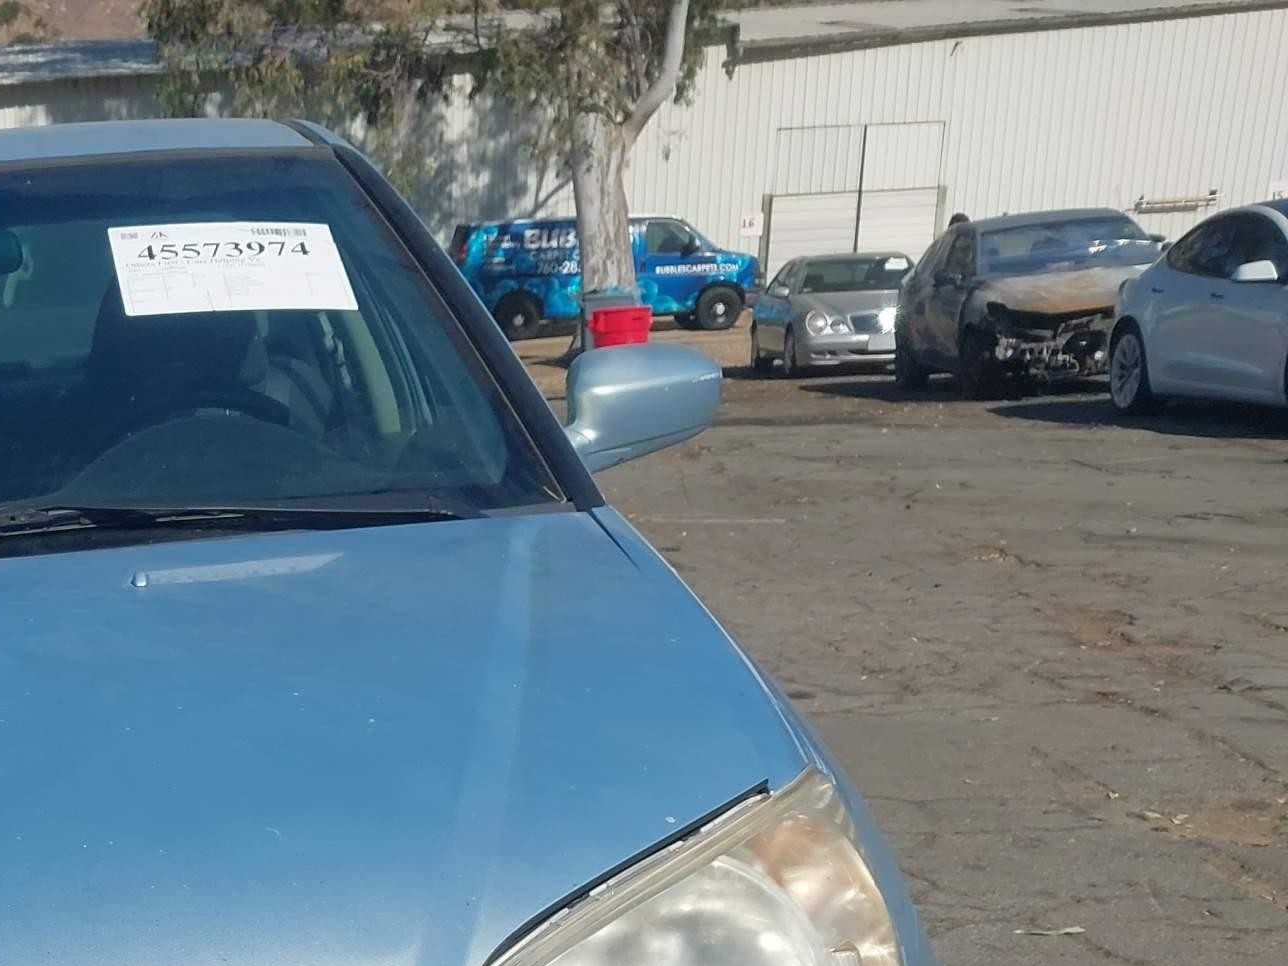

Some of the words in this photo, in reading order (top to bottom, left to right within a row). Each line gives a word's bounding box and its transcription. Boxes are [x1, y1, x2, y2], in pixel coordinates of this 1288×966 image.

[741, 218, 756, 229] 16
[524, 229, 579, 249] BUB
[137, 241, 310, 261] 45573974
[536, 261, 581, 274] 760-28
